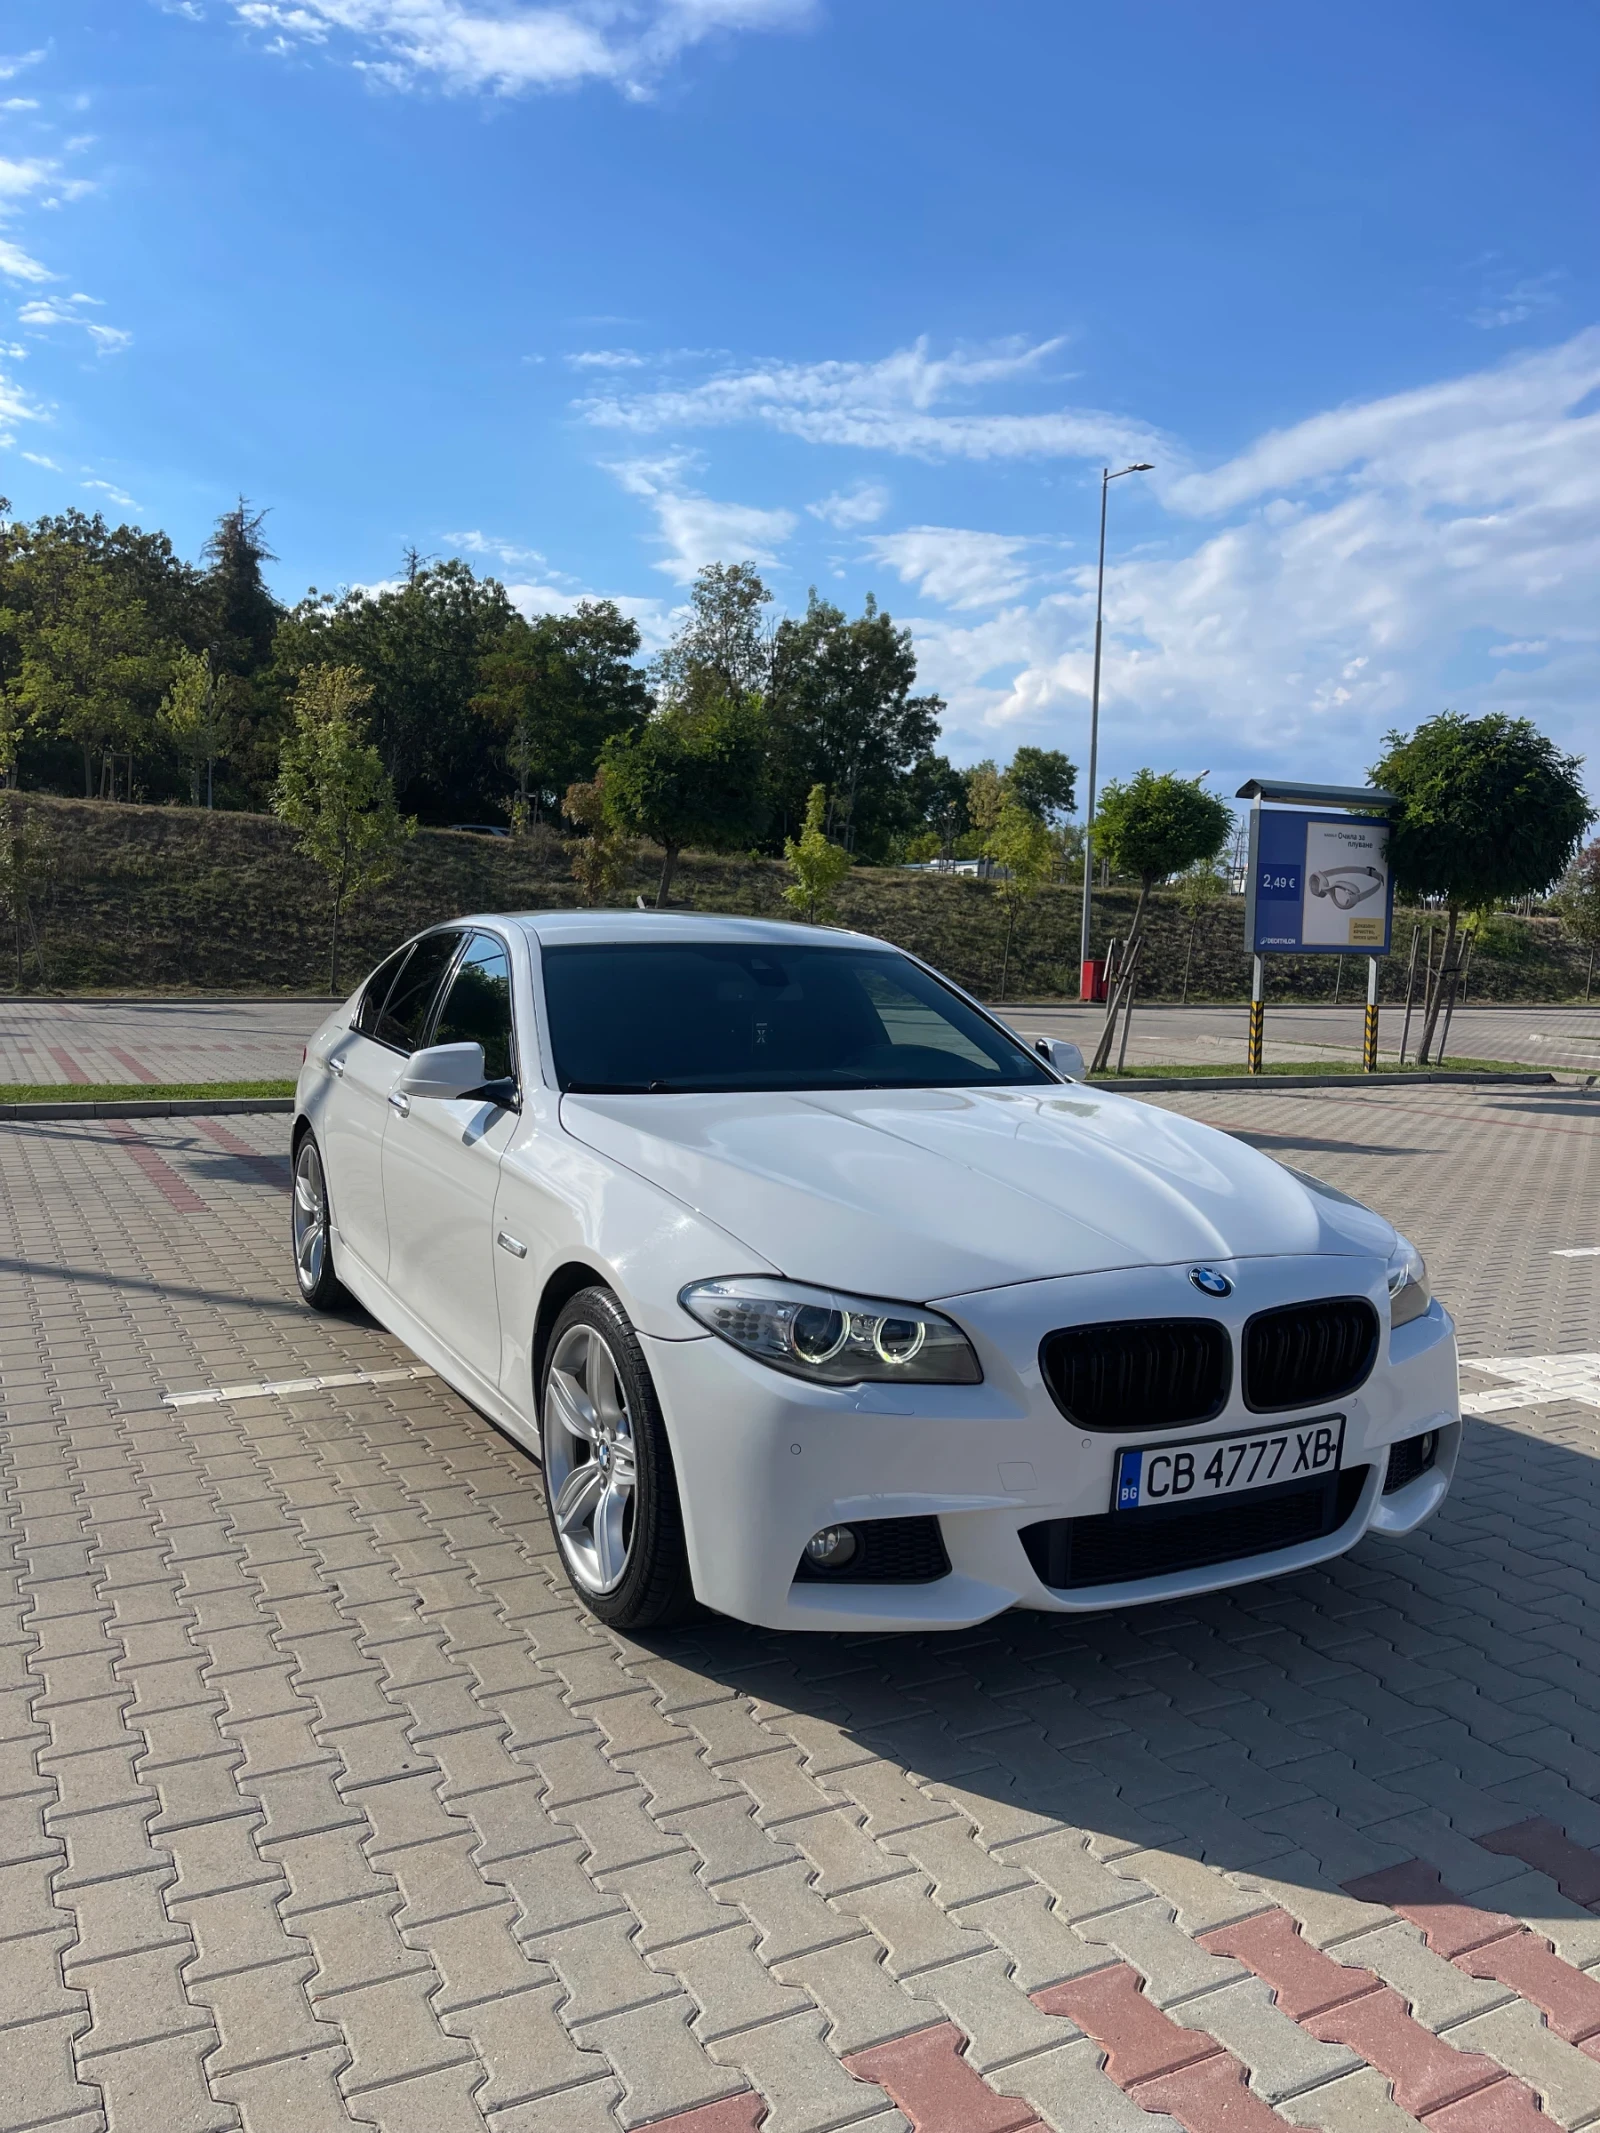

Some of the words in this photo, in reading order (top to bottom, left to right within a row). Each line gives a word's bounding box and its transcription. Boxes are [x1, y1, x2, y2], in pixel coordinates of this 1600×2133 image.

[1338, 832, 1357, 840] Очила
[1347, 841, 1373, 849] плуване
[1263, 874, 1287, 890] 2,49
[1289, 878, 1295, 888] €
[1147, 1452, 1196, 1498] CB
[1204, 1436, 1288, 1489] 4777
[1292, 1428, 1333, 1474] XB
[1121, 1486, 1138, 1501] BG
